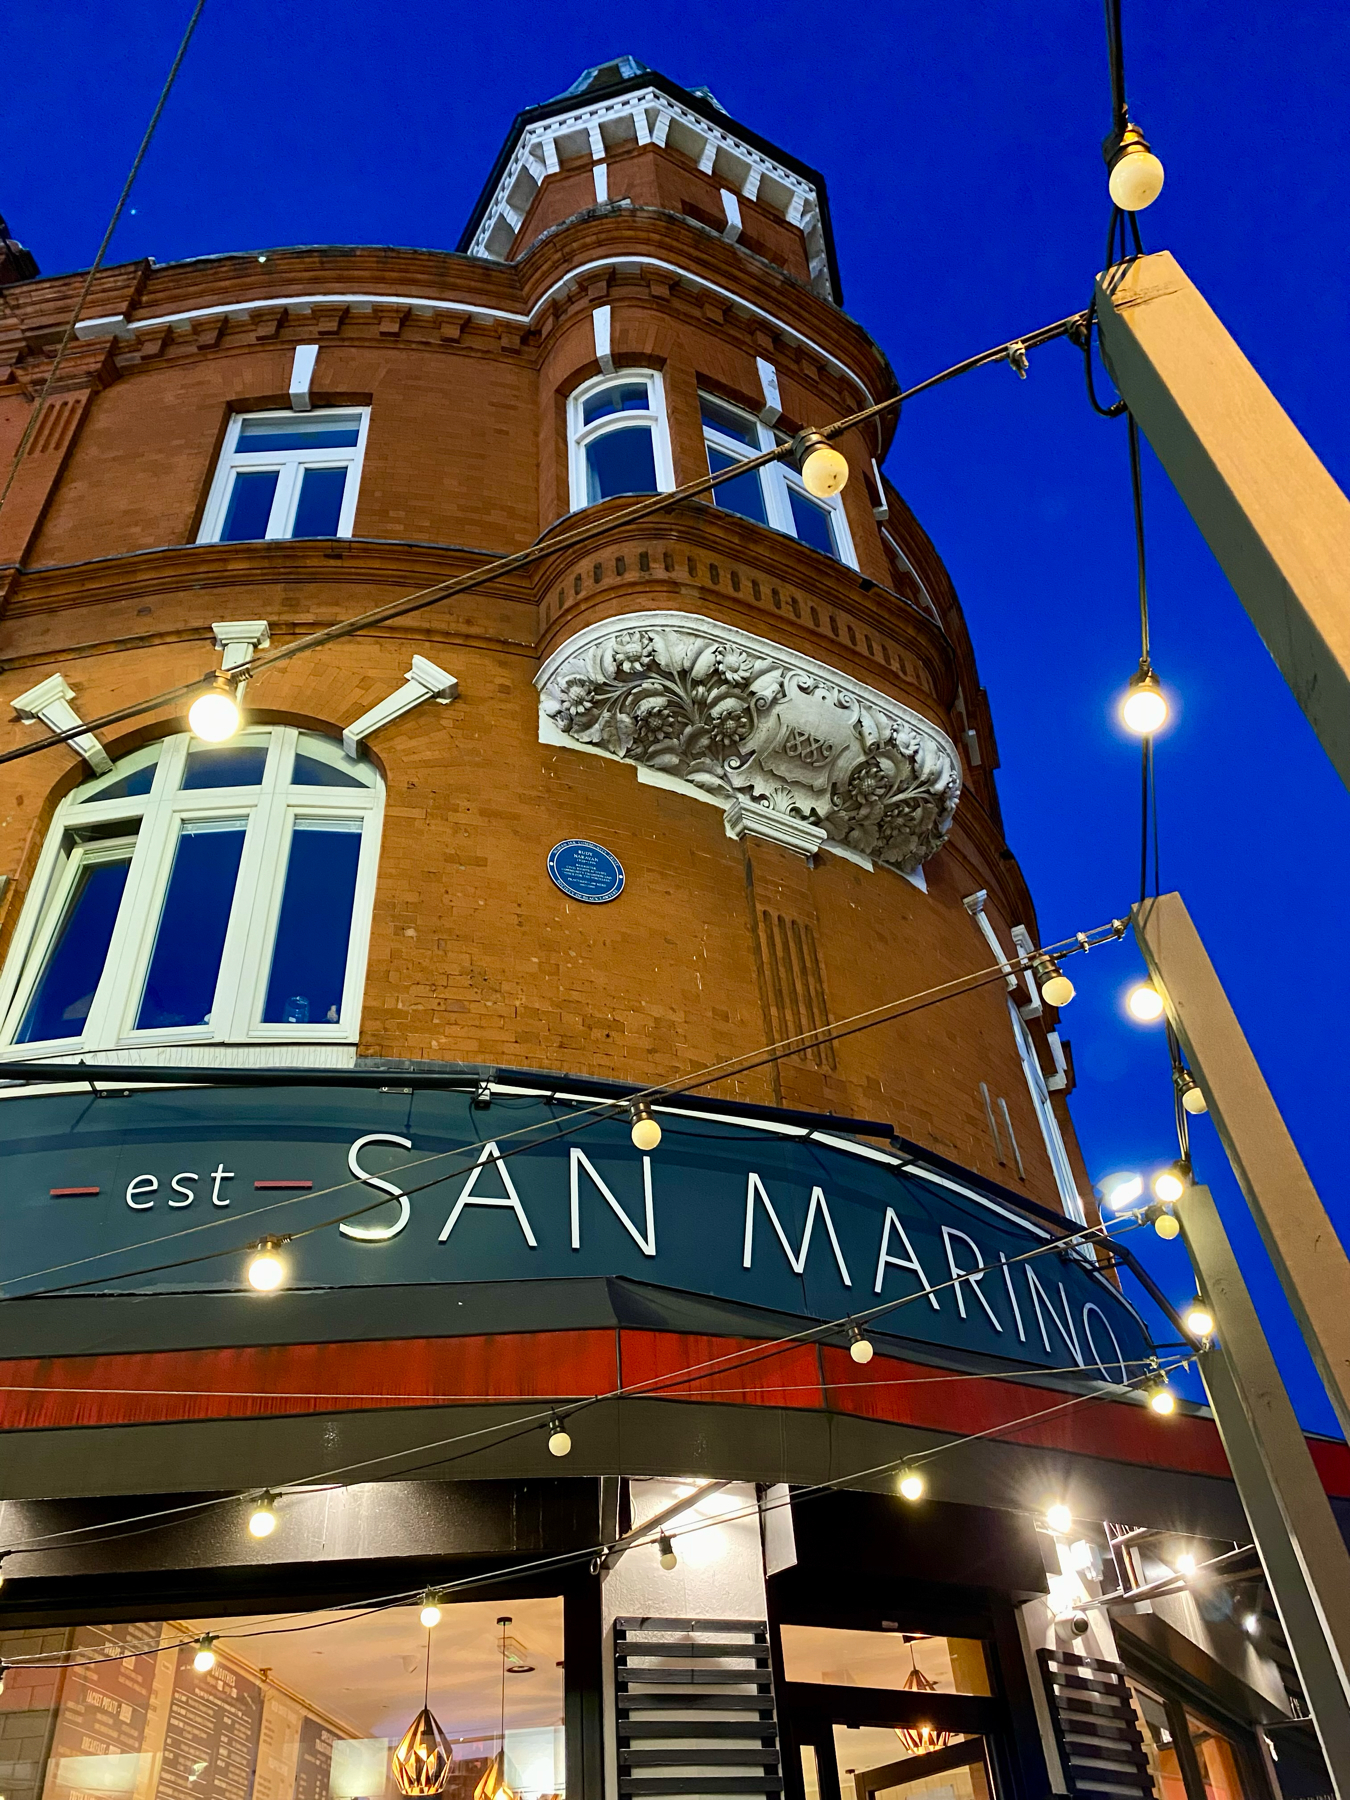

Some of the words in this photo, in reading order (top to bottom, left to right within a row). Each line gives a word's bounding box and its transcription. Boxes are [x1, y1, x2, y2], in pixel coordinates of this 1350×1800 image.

[774, 723, 834, 767] 1889
[125, 1163, 235, 1210] est
[339, 1132, 657, 1257] SAN
[742, 1172, 1128, 1384] MARINO
